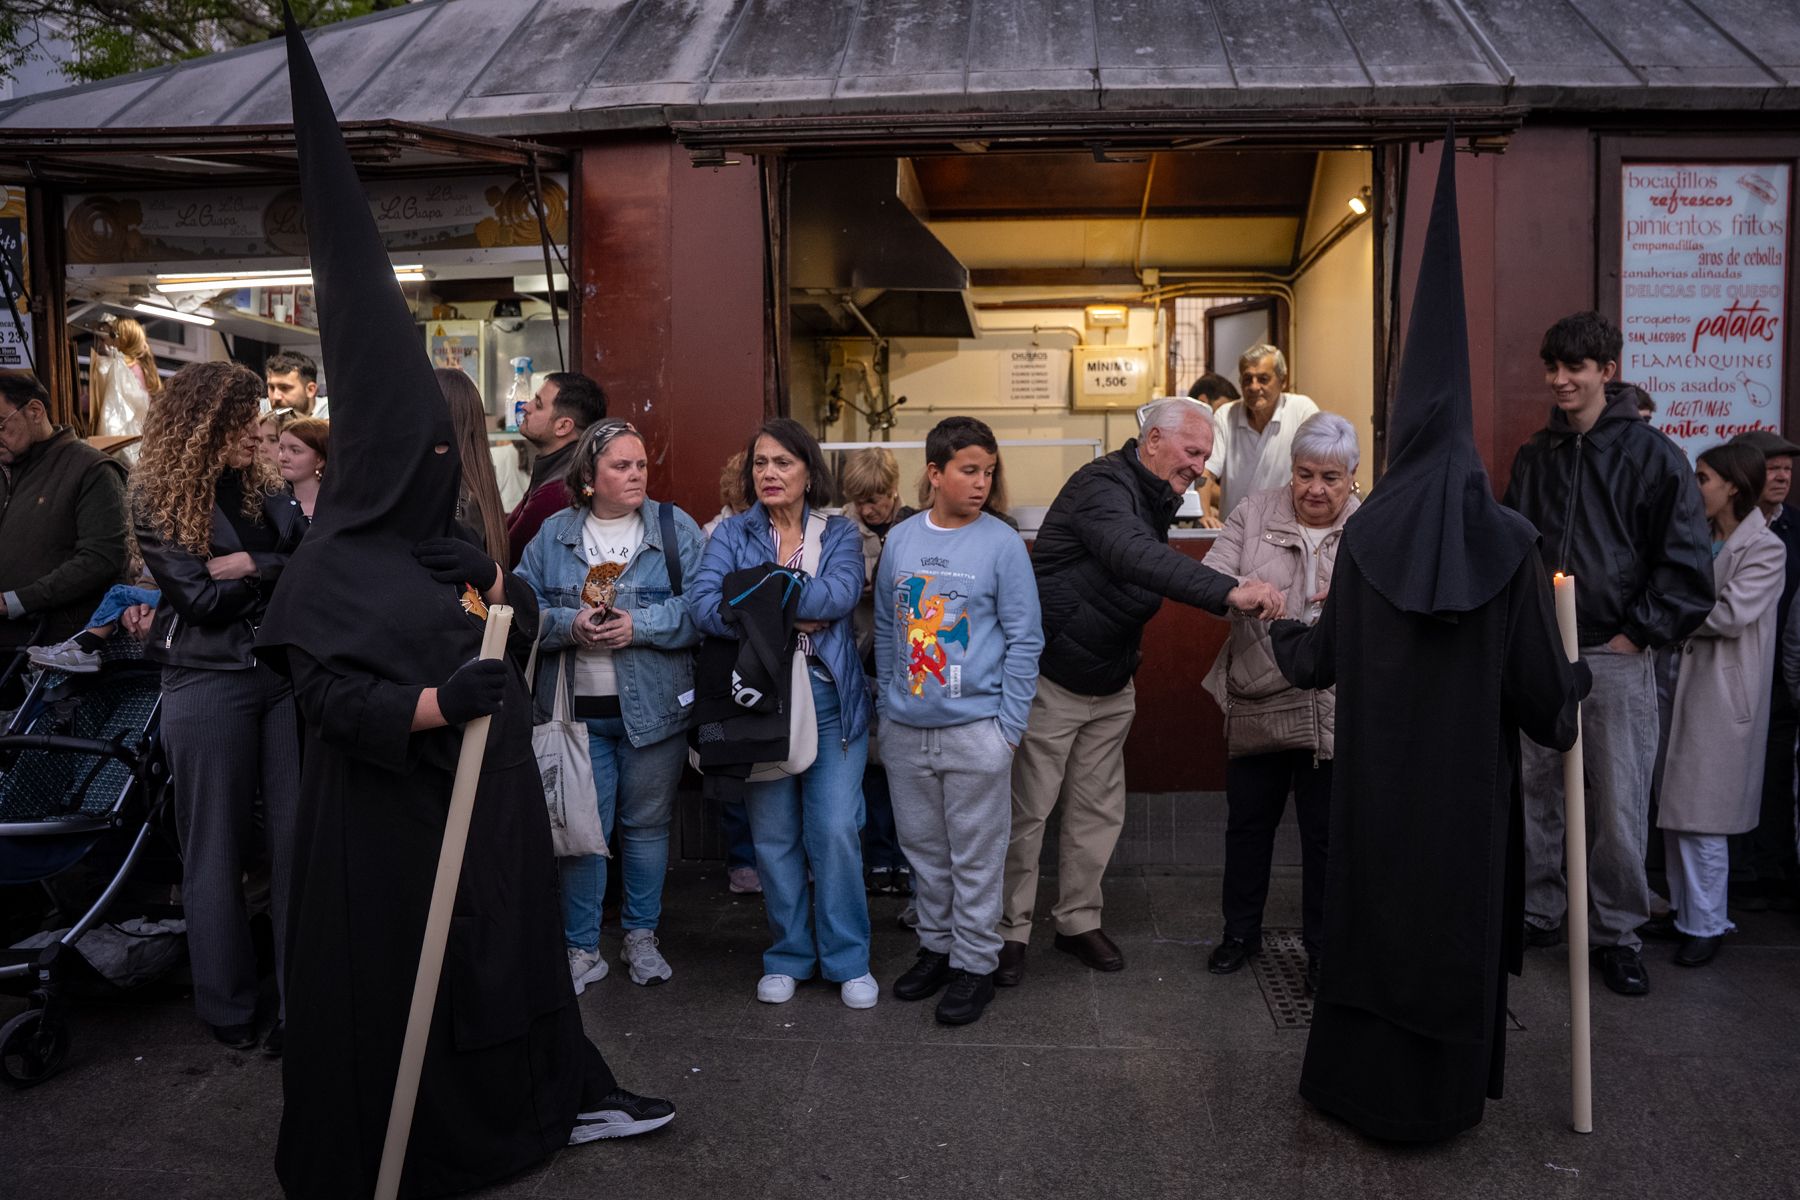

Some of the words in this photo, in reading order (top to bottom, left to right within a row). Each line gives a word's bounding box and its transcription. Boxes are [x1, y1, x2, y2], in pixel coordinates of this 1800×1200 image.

[1629, 171, 1718, 189] bocadillos
[377, 196, 400, 221] La
[402, 196, 444, 223] Guapa
[1649, 189, 1734, 214] refrescos
[175, 203, 197, 228] La
[198, 204, 238, 229] Guapa
[1627, 214, 1722, 241] pimientos
[1732, 213, 1784, 237] fritos
[1632, 239, 1705, 254] empanadillas
[1698, 252, 1724, 266] aros
[1727, 247, 1740, 266] de
[1743, 246, 1783, 267] cebolla
[1623, 266, 1689, 280] zanahorias
[1691, 266, 1743, 280] aliñadas
[1625, 284, 1697, 298] DELICIAS
[1701, 284, 1722, 298] DE
[1726, 284, 1781, 298] QUESO
[1626, 313, 1692, 328] croquetas
[1692, 299, 1780, 354] patatas
[1627, 332, 1648, 346] SAN
[1647, 332, 1687, 344] JACOBOS
[1631, 353, 1773, 371] FLAMENQUINES
[1094, 377, 1127, 388] 1,50€
[1629, 376, 1676, 393] ollos
[1680, 376, 1737, 393] asados
[1666, 399, 1733, 418] ACEITUNAS
